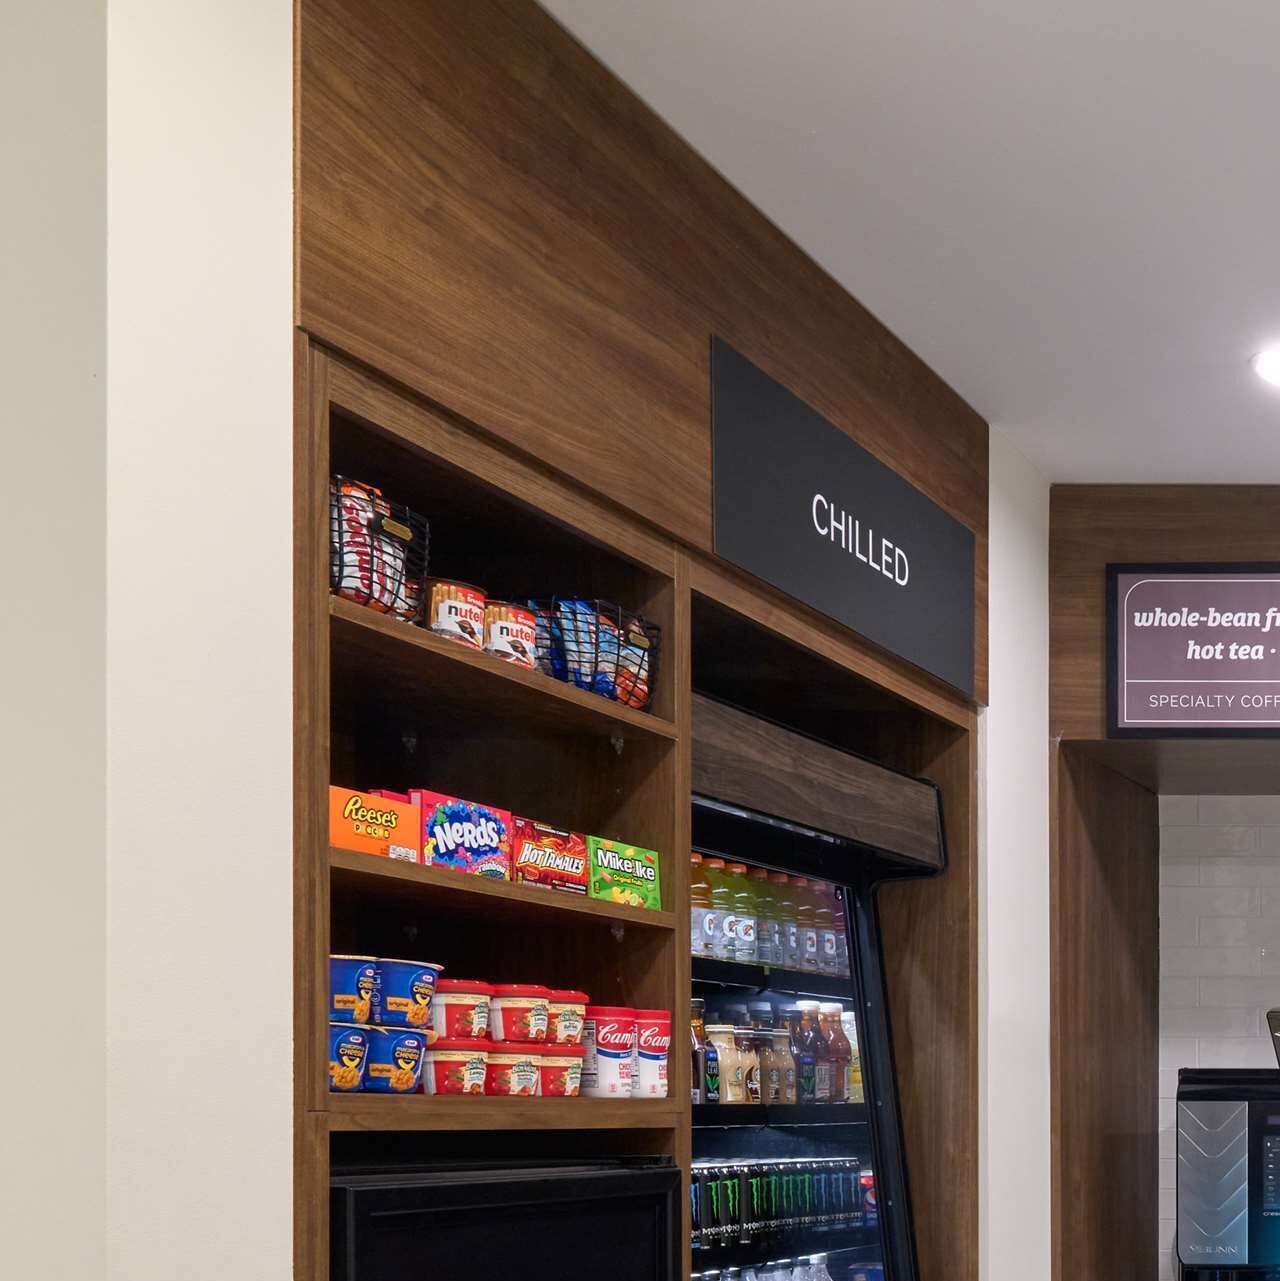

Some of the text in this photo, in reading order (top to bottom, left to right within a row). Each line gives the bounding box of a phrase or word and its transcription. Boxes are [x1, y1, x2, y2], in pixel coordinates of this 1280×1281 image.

[812, 493, 909, 586] CHILLED
[1133, 607, 1261, 627] whole-bean
[1186, 640, 1223, 660] hot
[1228, 642, 1264, 660] tea
[1149, 694, 1235, 708] SPECIALTY
[543, 847, 584, 874] TAMALES
[597, 849, 655, 881] Mike Ike
